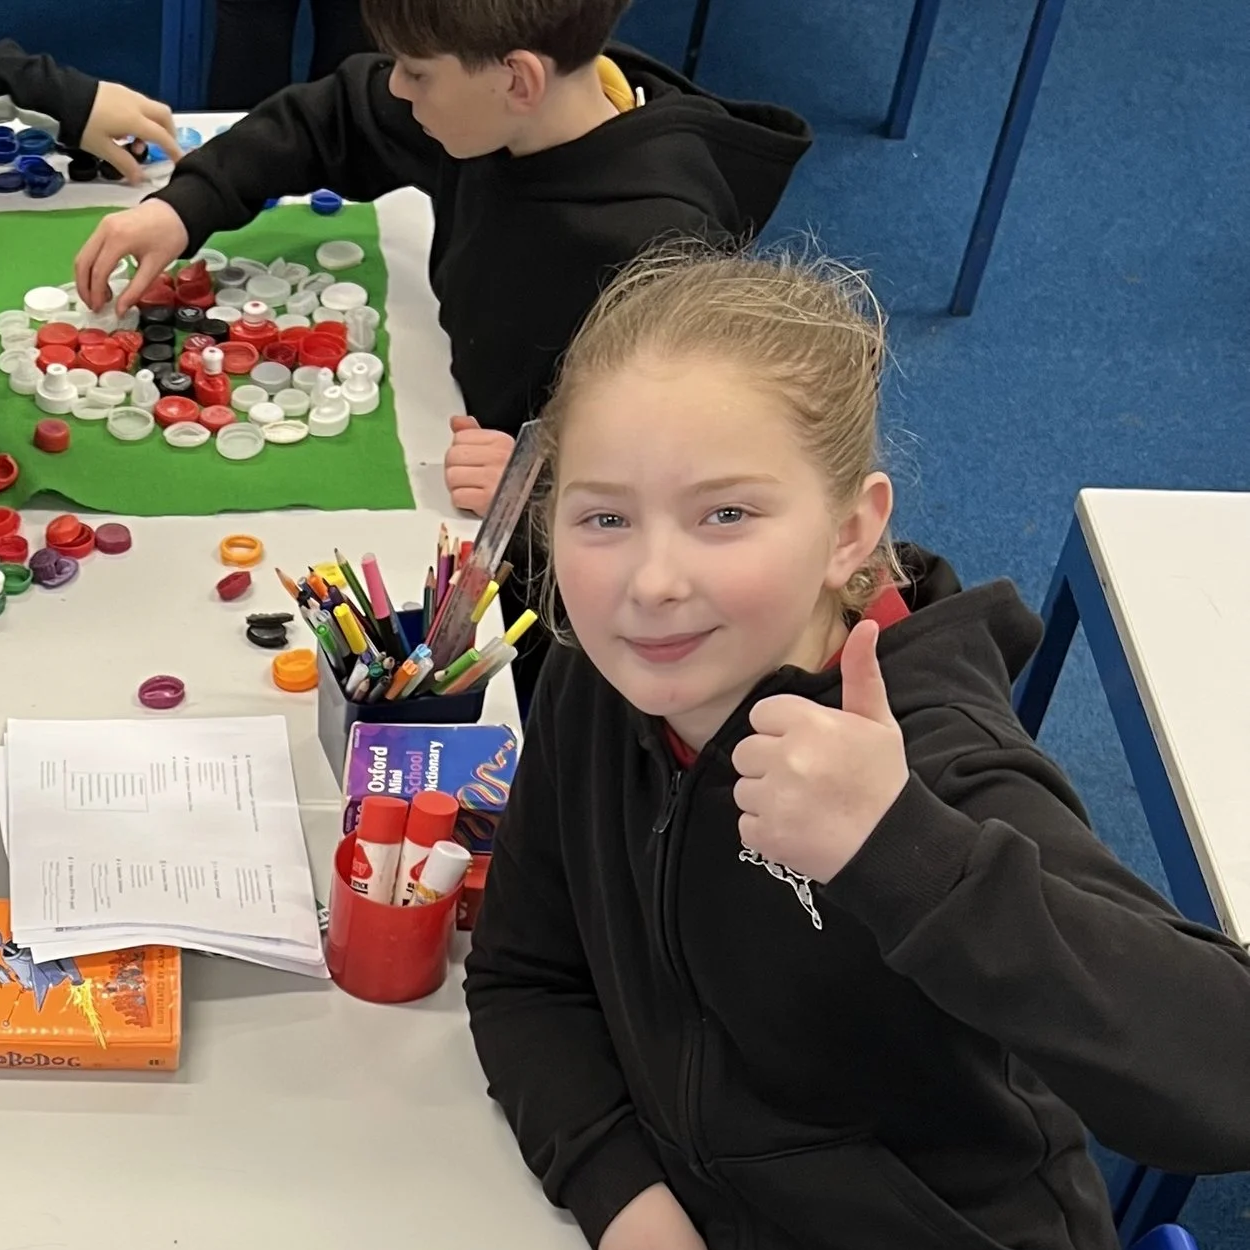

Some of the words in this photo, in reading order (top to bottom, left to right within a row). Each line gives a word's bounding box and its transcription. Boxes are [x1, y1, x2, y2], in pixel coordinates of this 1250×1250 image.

[367, 746, 388, 793] Oxford
[388, 769, 403, 794] Mini
[404, 750, 424, 794] School
